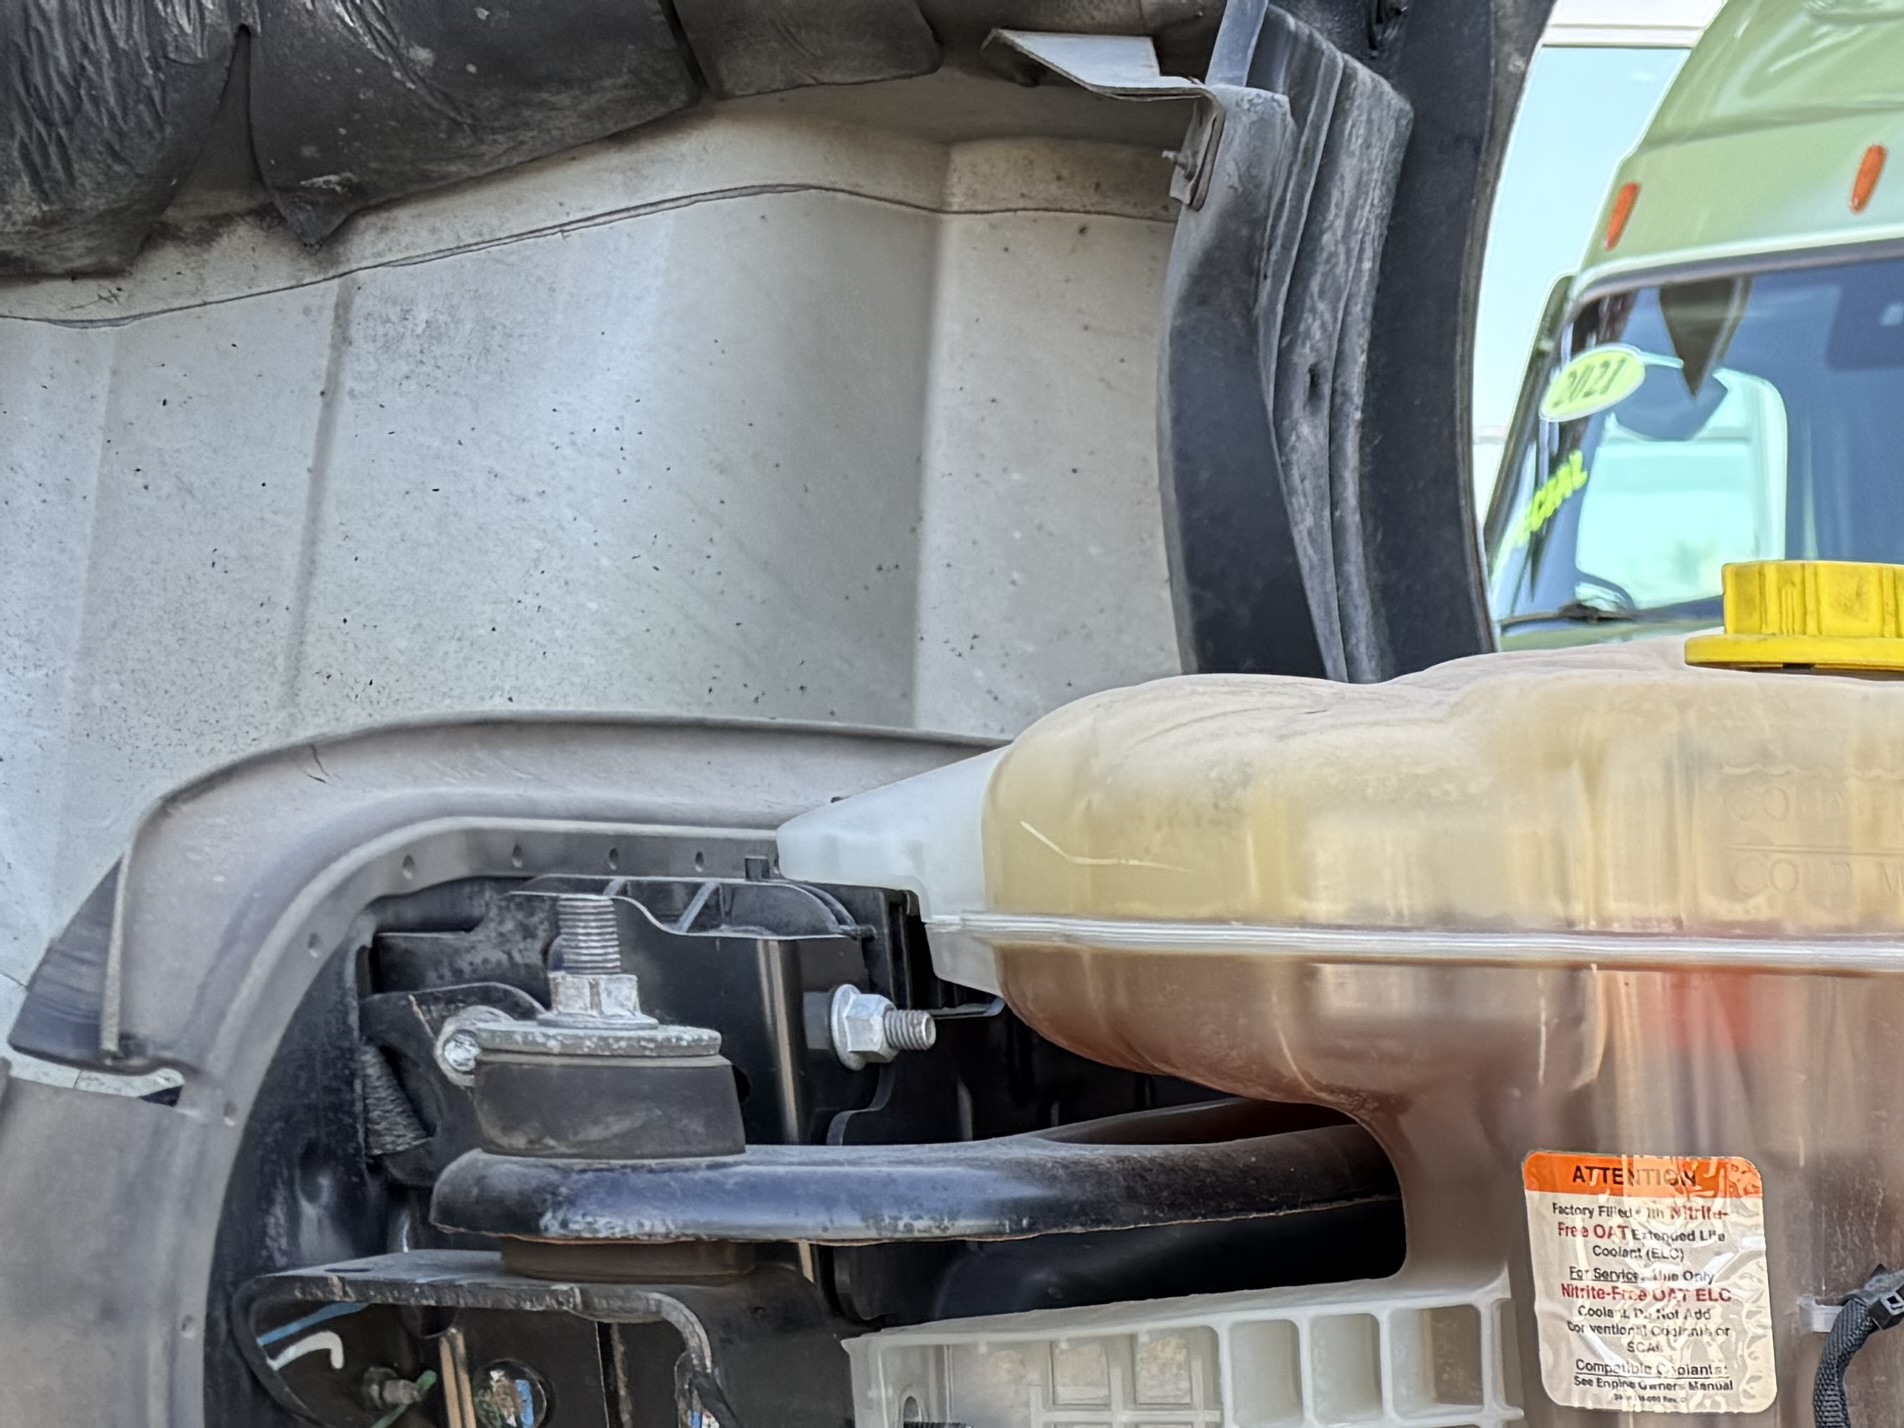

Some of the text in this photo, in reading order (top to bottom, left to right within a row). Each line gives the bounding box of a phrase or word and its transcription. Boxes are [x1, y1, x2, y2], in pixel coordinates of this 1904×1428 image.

[1552, 356, 1628, 409] 2021
[1572, 1164, 1698, 1187] ATTENTION
[1552, 1202, 1594, 1219] Factory
[1646, 1247, 1685, 1263] (ELC)
[1695, 1288, 1732, 1302] ELC
[1573, 1376, 1594, 1387] See
[1688, 1379, 1734, 1391] Manual
